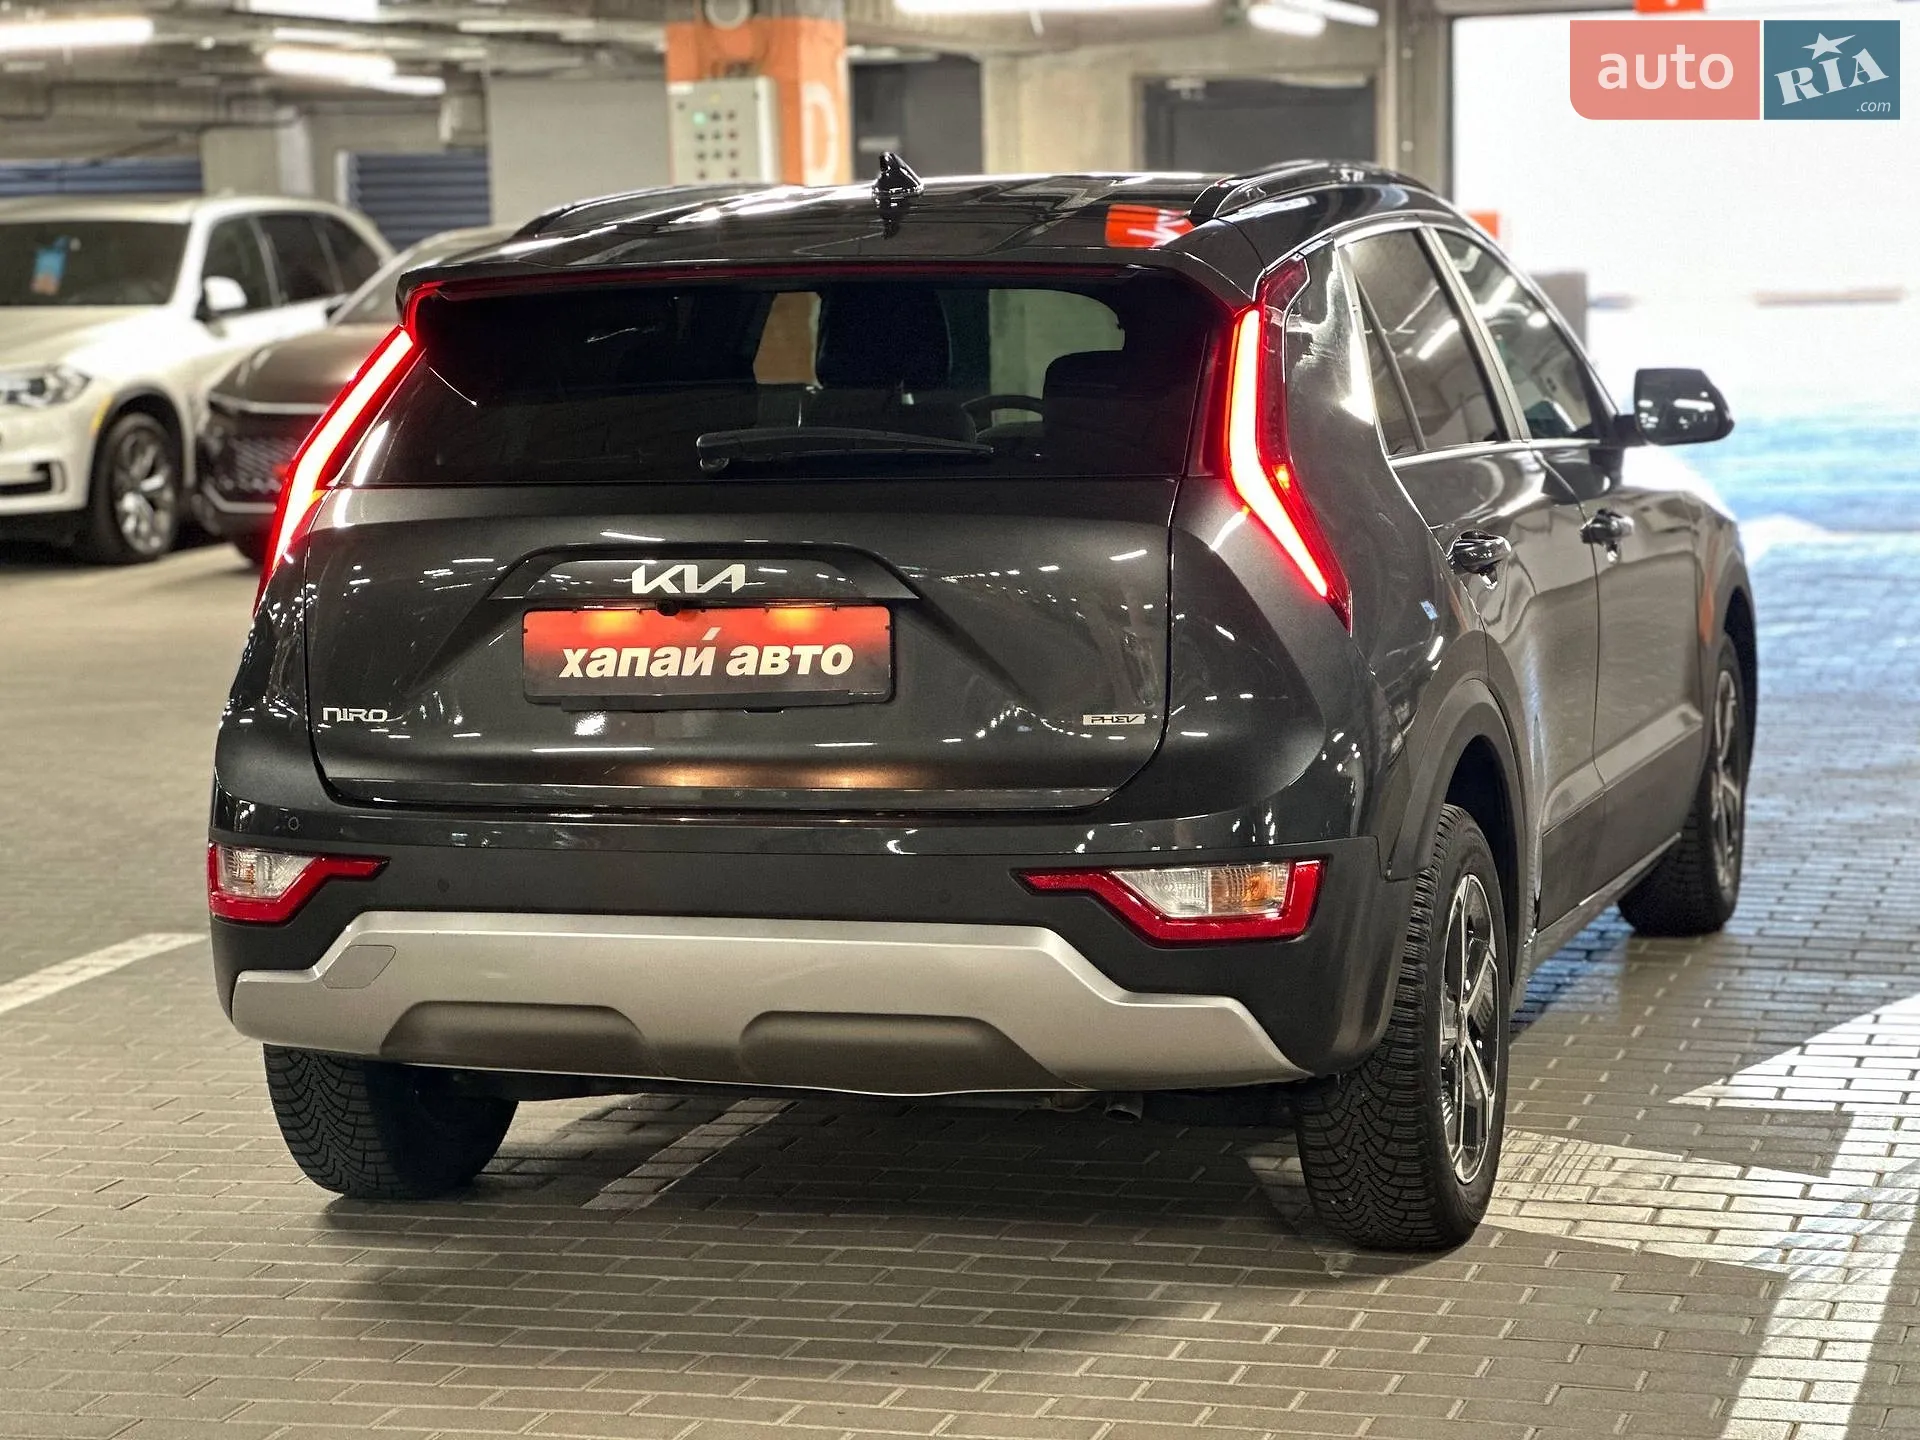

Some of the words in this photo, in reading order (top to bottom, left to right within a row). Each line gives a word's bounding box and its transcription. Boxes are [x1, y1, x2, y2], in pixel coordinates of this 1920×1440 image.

[631, 564, 746, 594] KIA
[558, 627, 721, 678] хапай
[726, 643, 854, 677] авто
[322, 707, 388, 722] NIRO
[1089, 714, 1140, 724] PHEV
